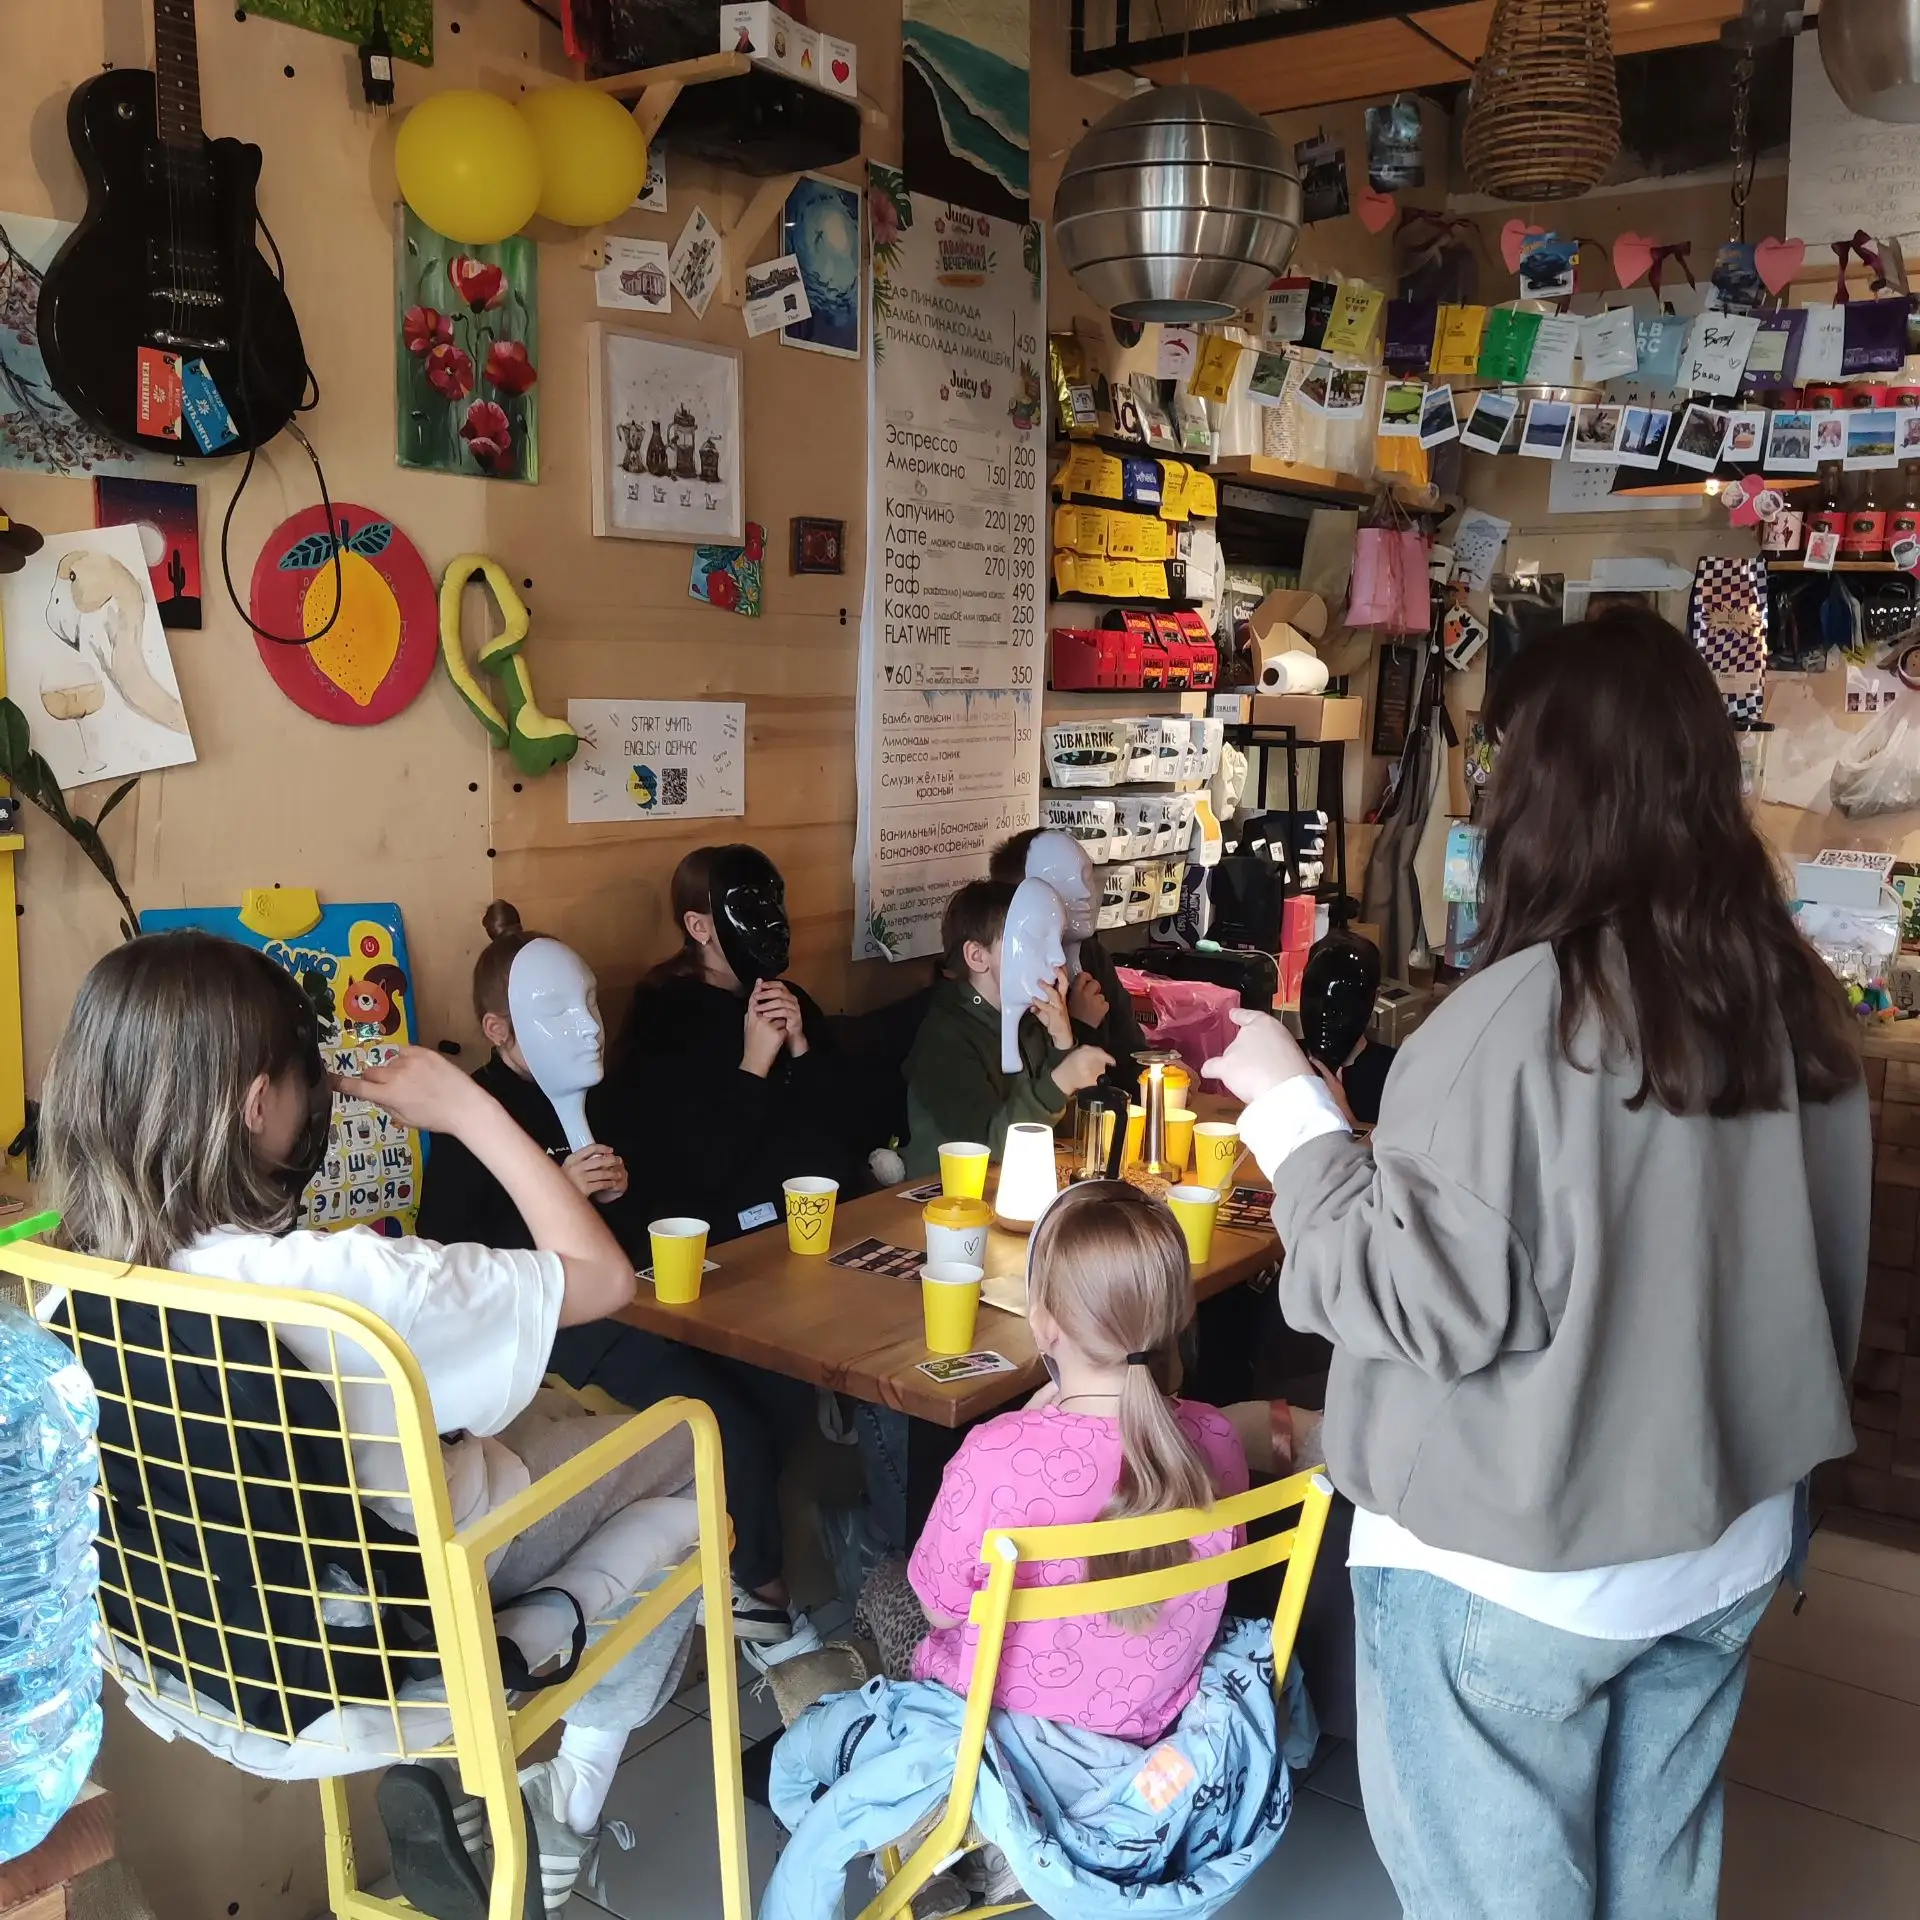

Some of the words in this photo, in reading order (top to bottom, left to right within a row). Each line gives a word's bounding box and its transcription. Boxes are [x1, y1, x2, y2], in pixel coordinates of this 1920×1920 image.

[945, 203, 974, 233] Juicy
[911, 287, 981, 320] ПИНАКОЛАДА
[886, 326, 959, 355] ПИНАКОЛАДА
[1016, 336, 1037, 354] 450
[924, 314, 993, 343] ПИНАКОЛАДА
[1637, 321, 1664, 337] LB
[1636, 337, 1661, 353] RC
[950, 369, 978, 397] Juicy
[886, 424, 958, 453] Эспрессо
[1014, 446, 1036, 467] 200
[886, 451, 966, 479] Американо
[987, 464, 1007, 486] 150
[1014, 469, 1036, 490] 200
[886, 497, 955, 524] Капучино
[984, 509, 1007, 530] 220
[1013, 513, 1035, 533] 290
[885, 523, 927, 545] Латте
[1013, 536, 1035, 556] 290
[885, 547, 921, 572] Раф
[984, 556, 1006, 576] 270
[1012, 560, 1035, 579] 390
[885, 573, 920, 598] Раф
[1012, 583, 1035, 602] 490
[885, 597, 930, 619] Какао
[1012, 605, 1034, 624] 250
[885, 624, 914, 645] FLAT
[916, 626, 951, 646] WHITE
[1012, 629, 1034, 647] 270
[1011, 665, 1033, 684] 350
[631, 715, 661, 733] START
[665, 716, 693, 732] УЧИТЬ
[882, 713, 912, 725] Бамбл
[882, 736, 930, 748] Лимонады
[1016, 728, 1032, 742] 350
[1053, 731, 1115, 749] SUBMARINE
[624, 740, 660, 756] ENGLISH
[882, 752, 929, 766] Эспрессо
[881, 773, 914, 789] Смузи
[916, 769, 954, 785] жёлтый
[1016, 770, 1031, 786] 480
[916, 783, 954, 800] красный
[880, 825, 936, 843] Ванильный
[996, 815, 1011, 831] 260
[1016, 812, 1031, 828] 350
[1049, 810, 1105, 825] SUBMARINE
[335, 1051, 354, 1071] Ж
[342, 1120, 354, 1139] Т
[376, 1115, 388, 1133] У
[348, 1152, 365, 1173] Ш
[382, 1148, 400, 1168] Щ
[313, 1193, 327, 1213] Э
[350, 1187, 367, 1205] Ю
[383, 1181, 395, 1200] Я
